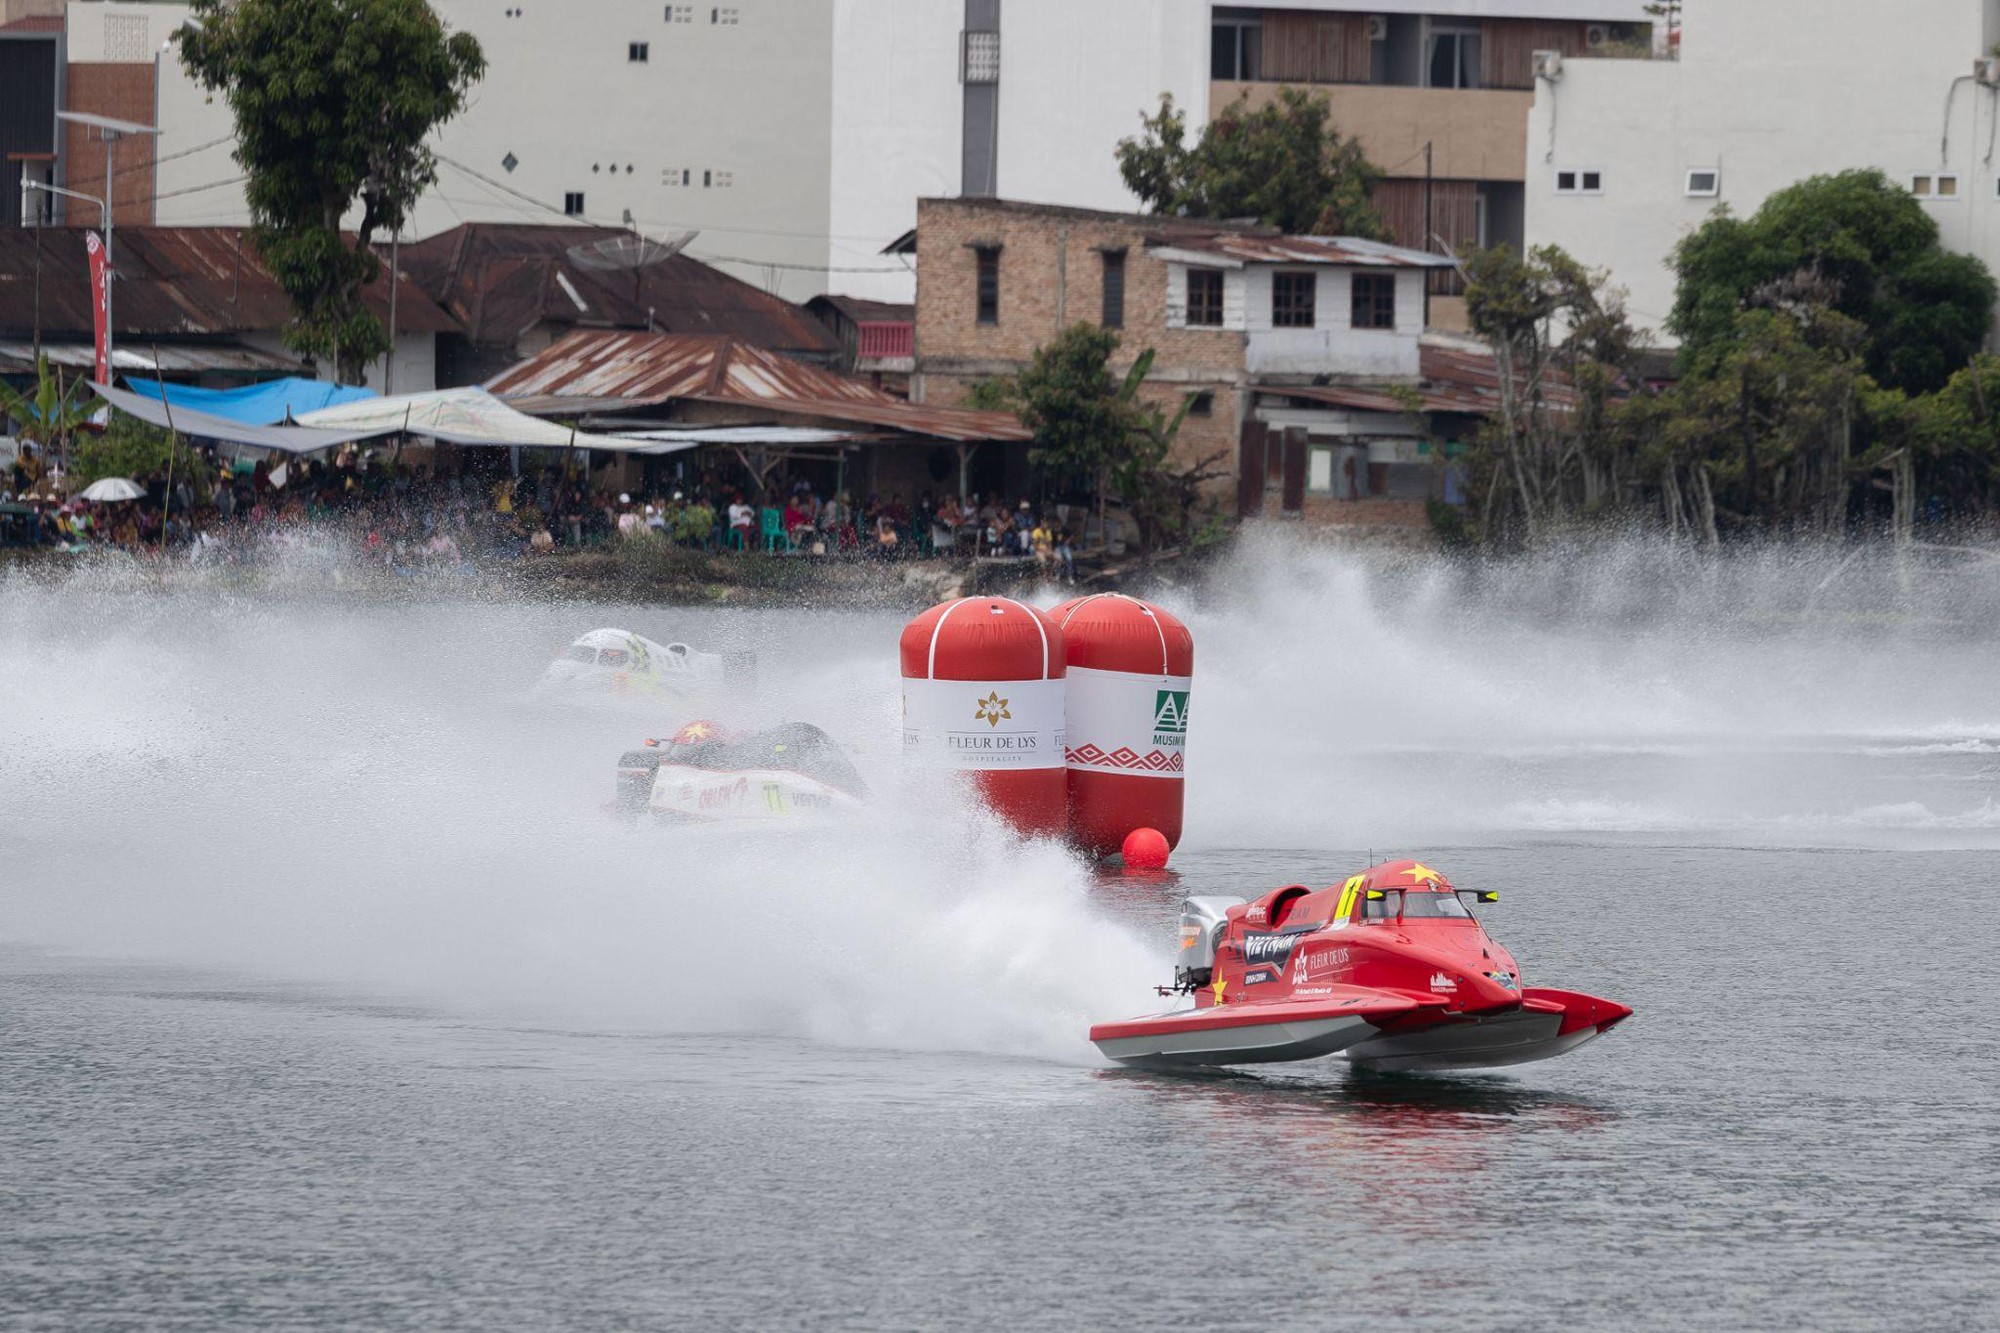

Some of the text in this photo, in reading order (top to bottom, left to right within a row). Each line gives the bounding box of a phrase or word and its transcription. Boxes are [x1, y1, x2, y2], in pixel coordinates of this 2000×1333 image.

[948, 736, 1036, 749] FLEUR DE LYS
[1153, 735, 1180, 746] MUSIM
[1245, 932, 1300, 960] VIETNAM
[1310, 947, 1349, 970] FLEUR DE LYS
